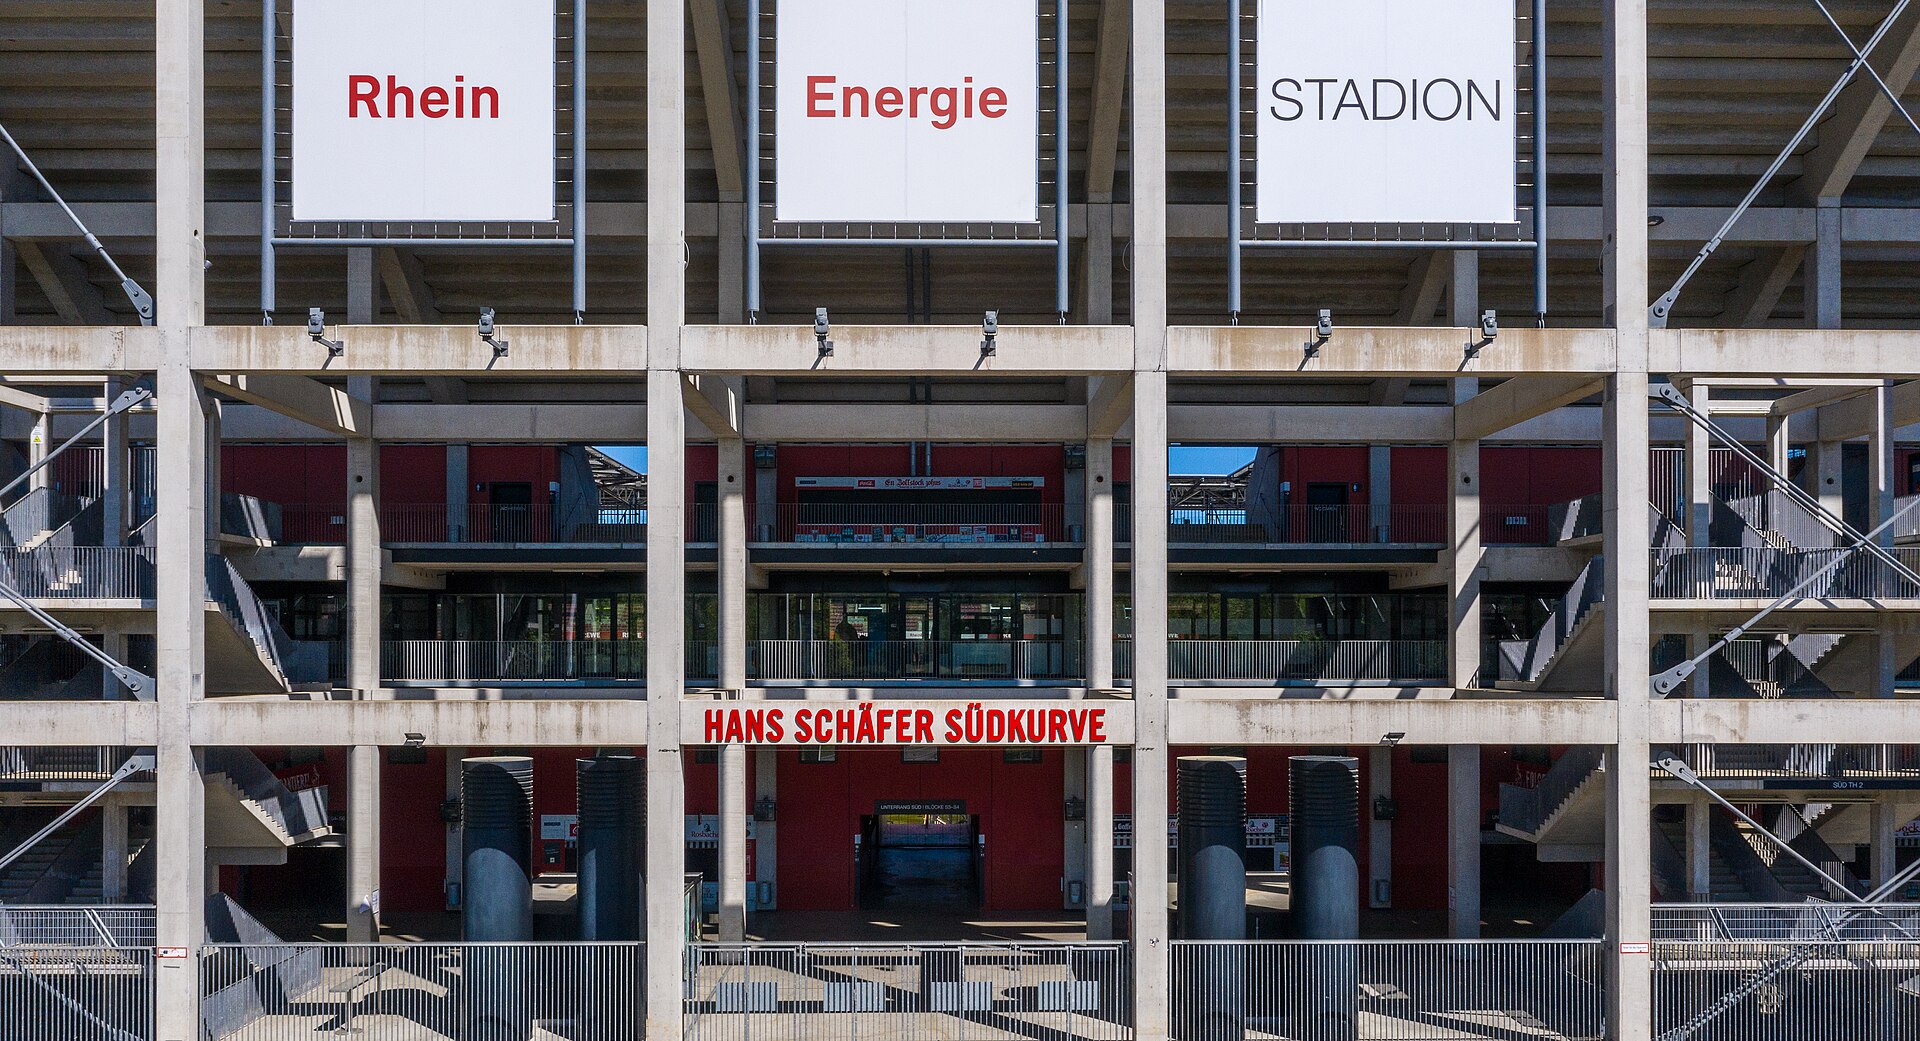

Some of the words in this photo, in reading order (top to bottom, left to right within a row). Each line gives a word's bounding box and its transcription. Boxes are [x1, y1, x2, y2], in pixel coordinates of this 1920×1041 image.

[348, 75, 500, 119] Rhein
[806, 75, 1008, 129] Energie
[1270, 77, 1501, 122] STADION
[705, 708, 786, 743] HANS
[795, 701, 936, 743] SCHÄFER
[945, 701, 1108, 743] SÜDKURVE
[1833, 781, 1847, 789] SÜD
[1849, 781, 1858, 789] TH
[1859, 781, 1865, 789] 2
